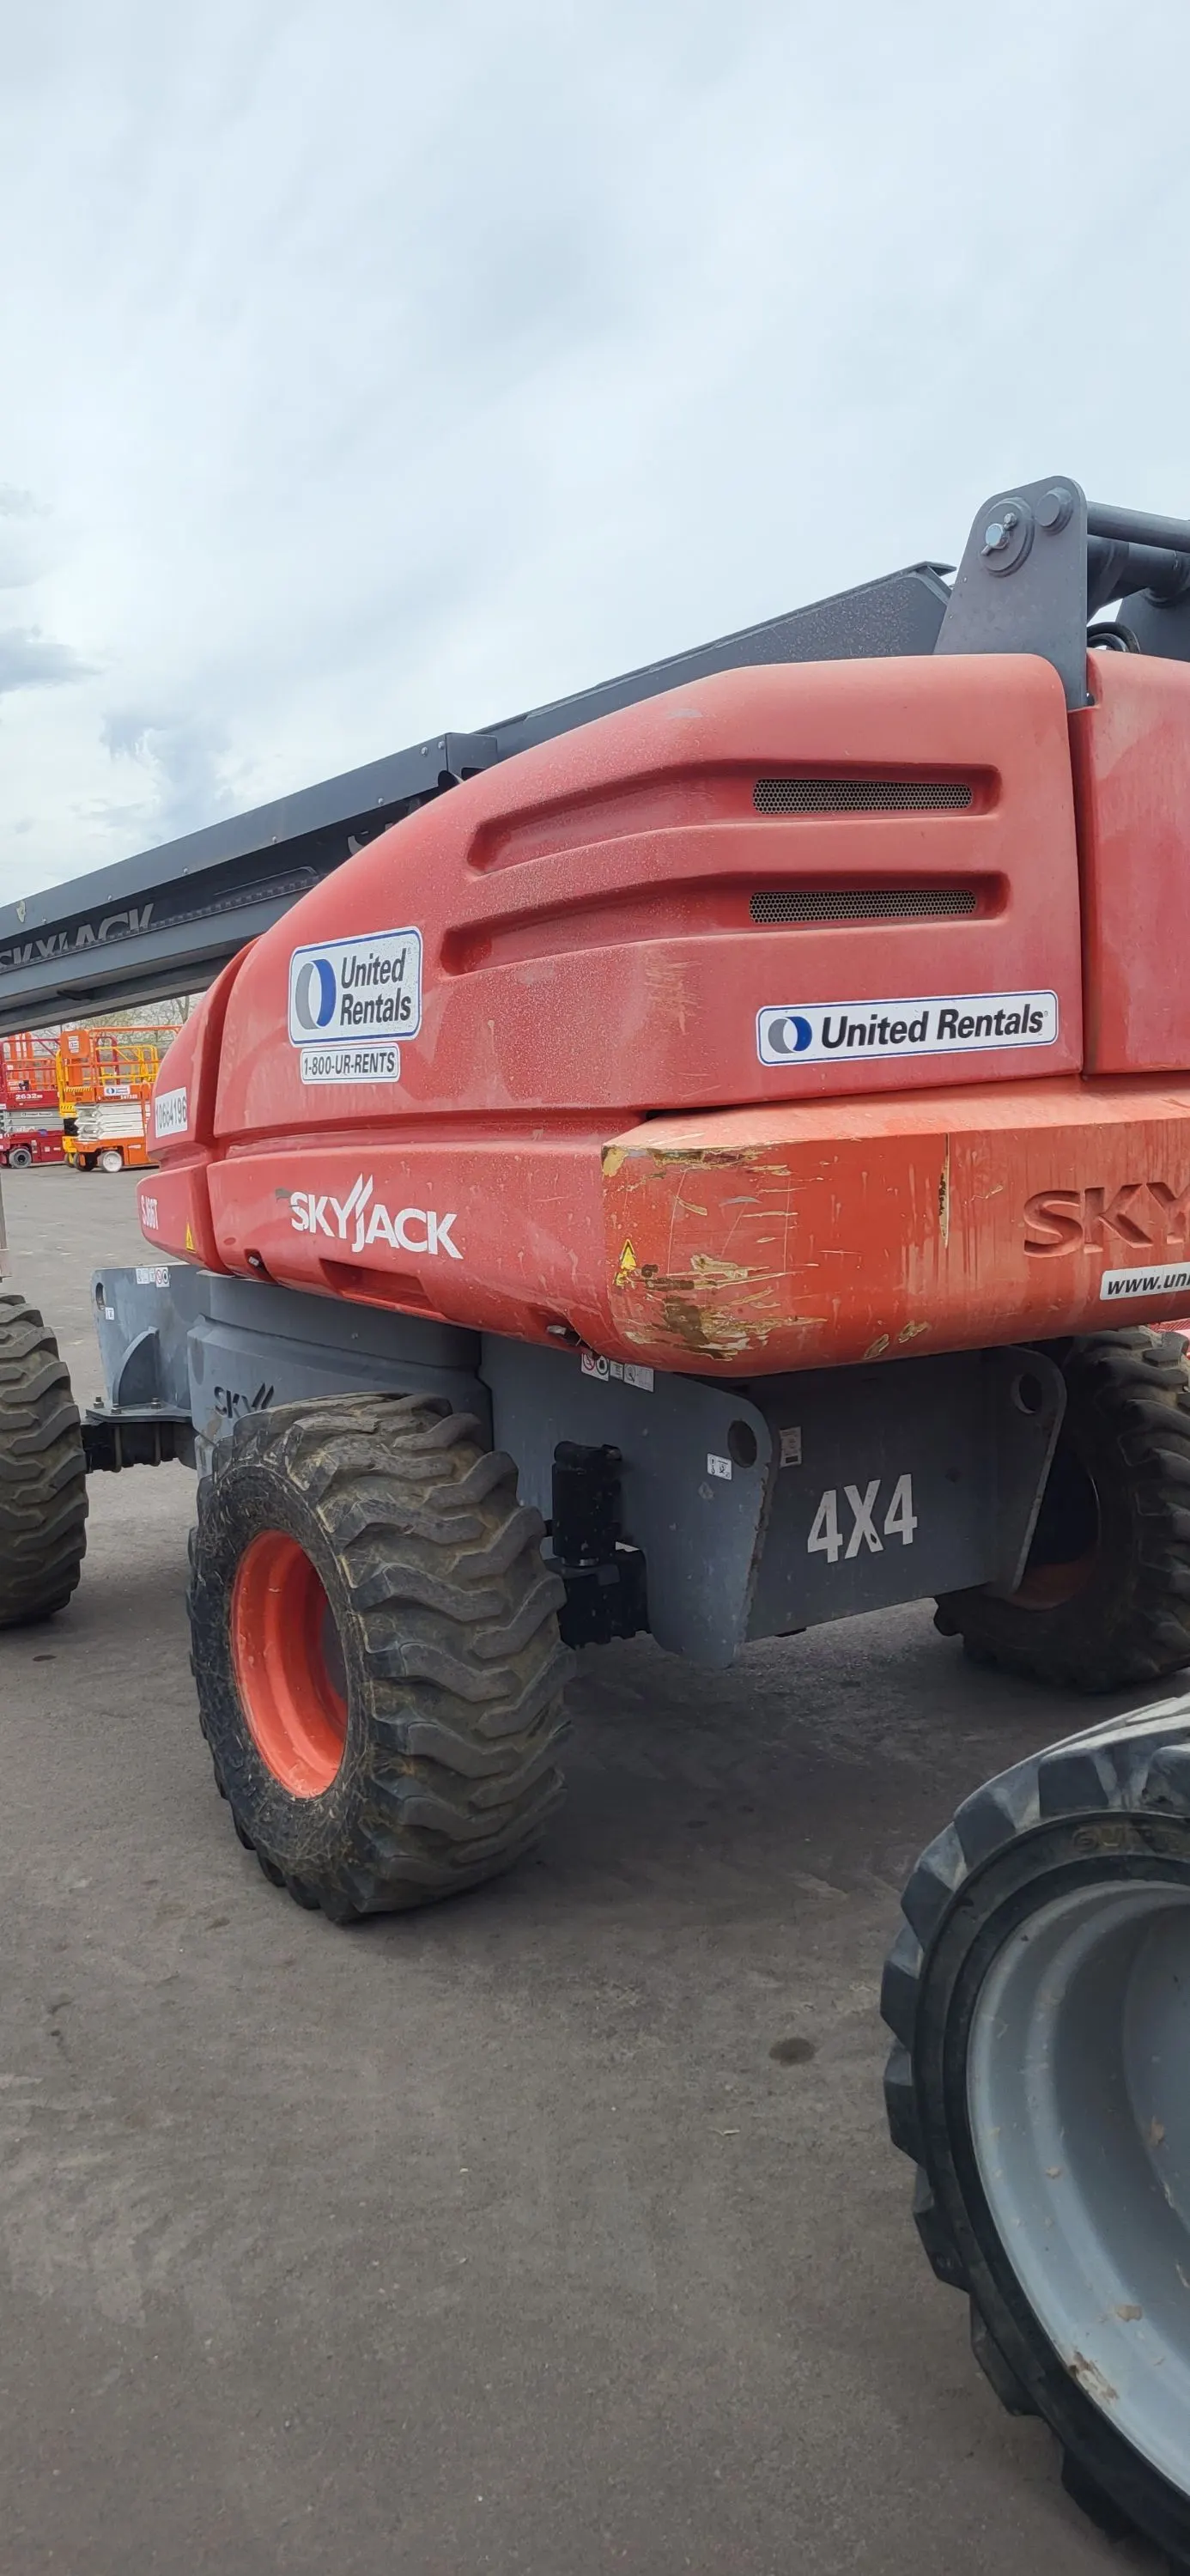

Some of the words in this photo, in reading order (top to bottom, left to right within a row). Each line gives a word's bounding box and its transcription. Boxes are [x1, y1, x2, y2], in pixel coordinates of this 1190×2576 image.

[341, 948, 406, 988] United
[340, 988, 411, 1025] Rentals
[822, 1011, 929, 1048] United
[937, 1004, 1043, 1040] Rentals
[304, 1052, 395, 1075] 1-800-UR-RENTS
[290, 1173, 464, 1259] SKYJACK
[807, 1474, 917, 1563] 4X4
